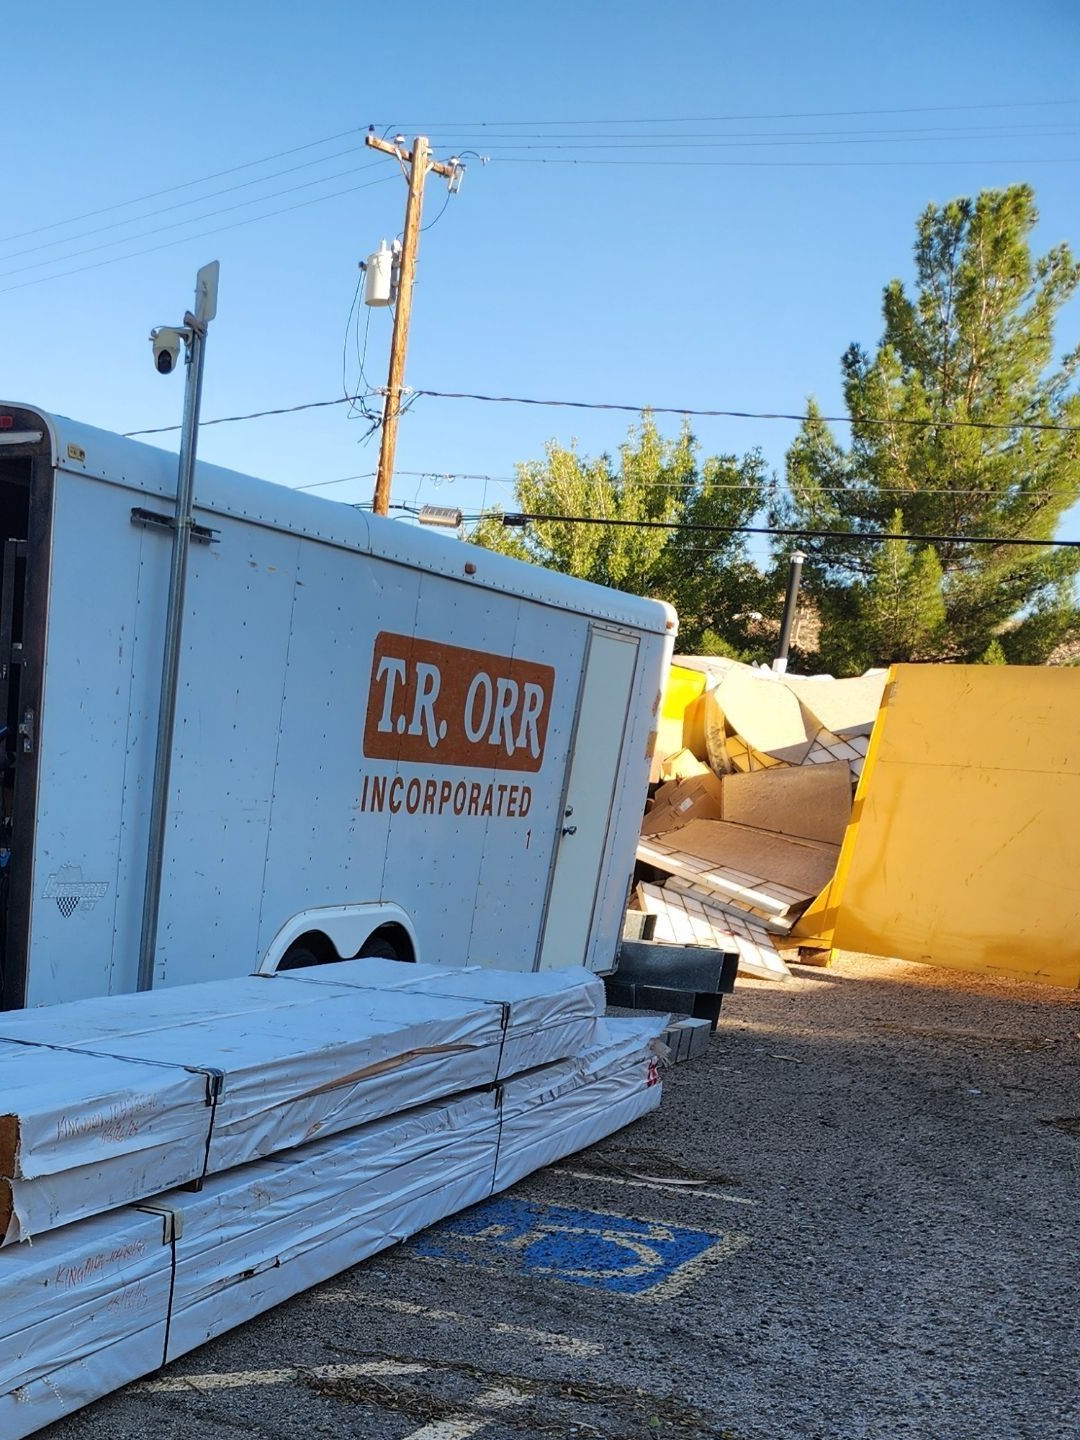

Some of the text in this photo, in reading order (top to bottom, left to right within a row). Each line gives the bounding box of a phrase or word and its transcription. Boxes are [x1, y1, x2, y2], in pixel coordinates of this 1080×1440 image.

[376, 655, 545, 759] T.R. ORR
[360, 775, 533, 818] INCORPORATED
